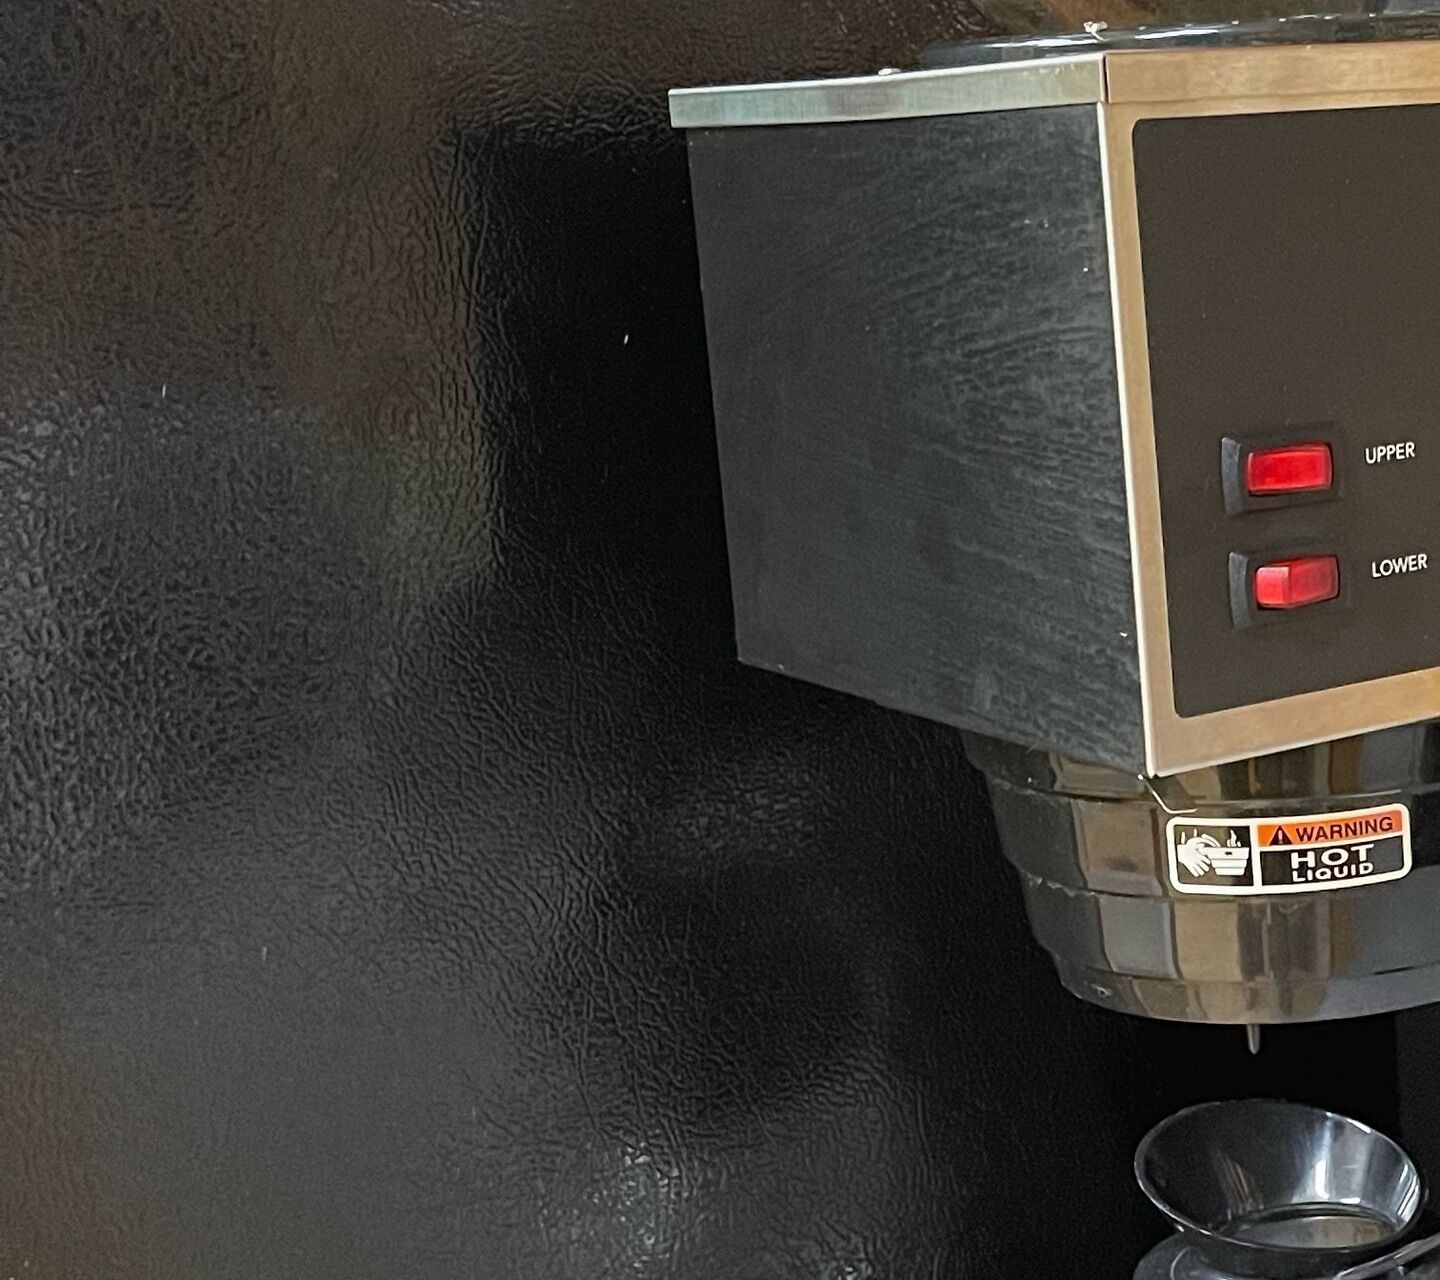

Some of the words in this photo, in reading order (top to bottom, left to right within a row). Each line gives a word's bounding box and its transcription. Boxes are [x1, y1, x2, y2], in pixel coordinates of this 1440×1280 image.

[1365, 441, 1415, 464] UPPER
[1372, 553, 1428, 578] LOWER
[1296, 816, 1393, 842] WARNING
[1290, 843, 1375, 869] HOT
[1292, 862, 1374, 882] LIQUID
